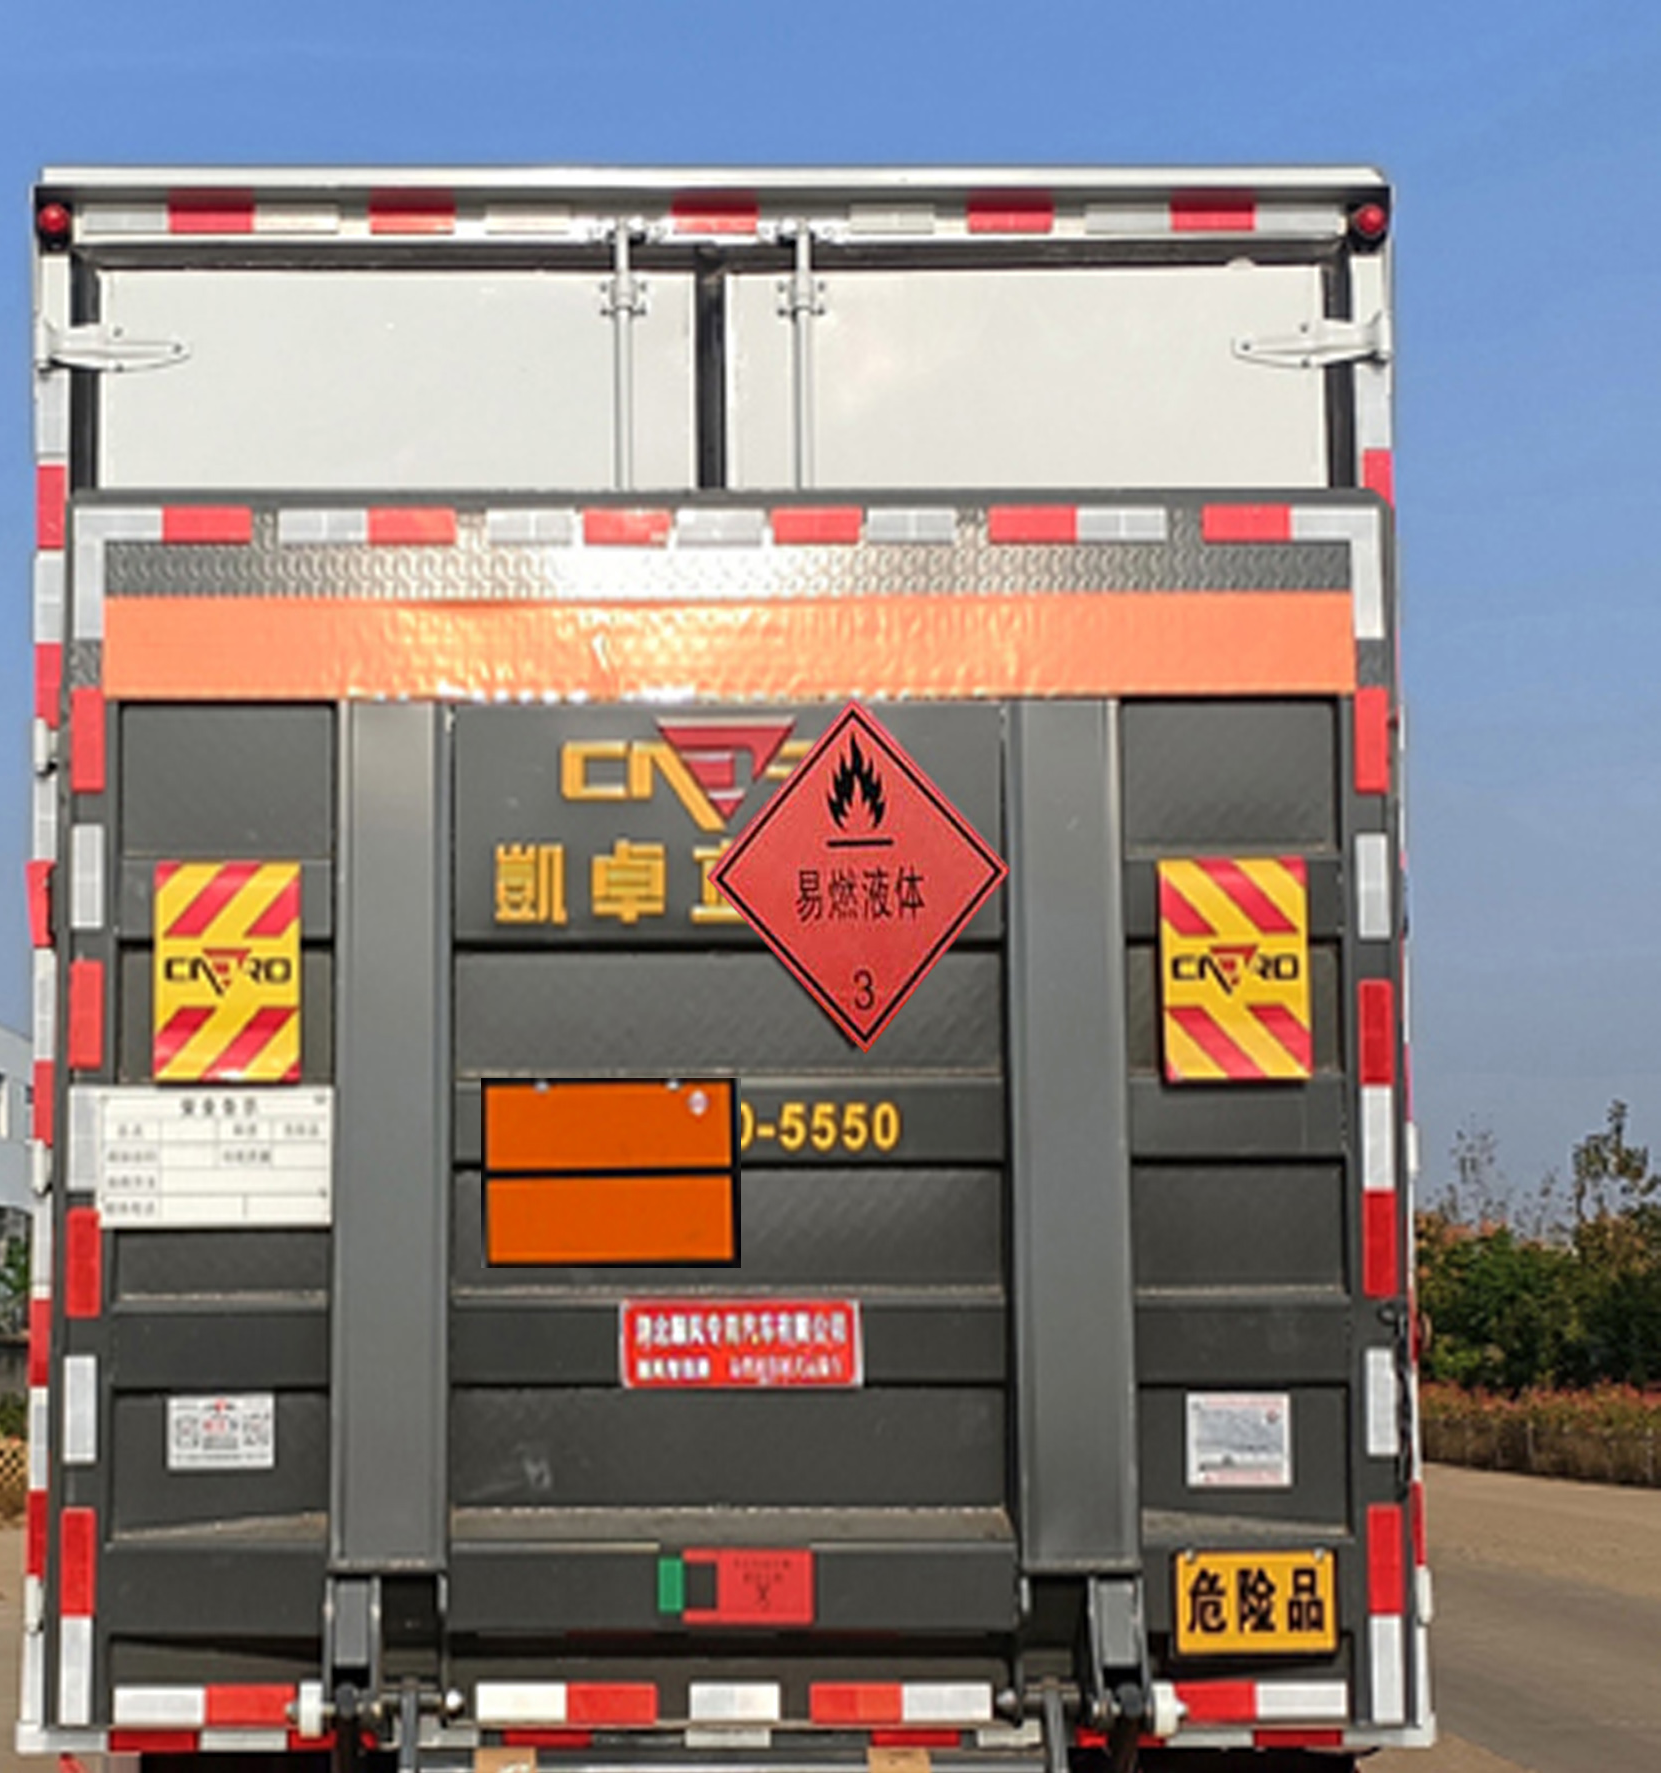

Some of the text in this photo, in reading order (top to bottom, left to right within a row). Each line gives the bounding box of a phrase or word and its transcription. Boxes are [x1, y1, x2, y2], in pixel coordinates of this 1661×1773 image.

[795, 868, 926, 923] 易燃液体
[852, 969, 875, 1012] 3
[1187, 1567, 1325, 1634] 危险品
